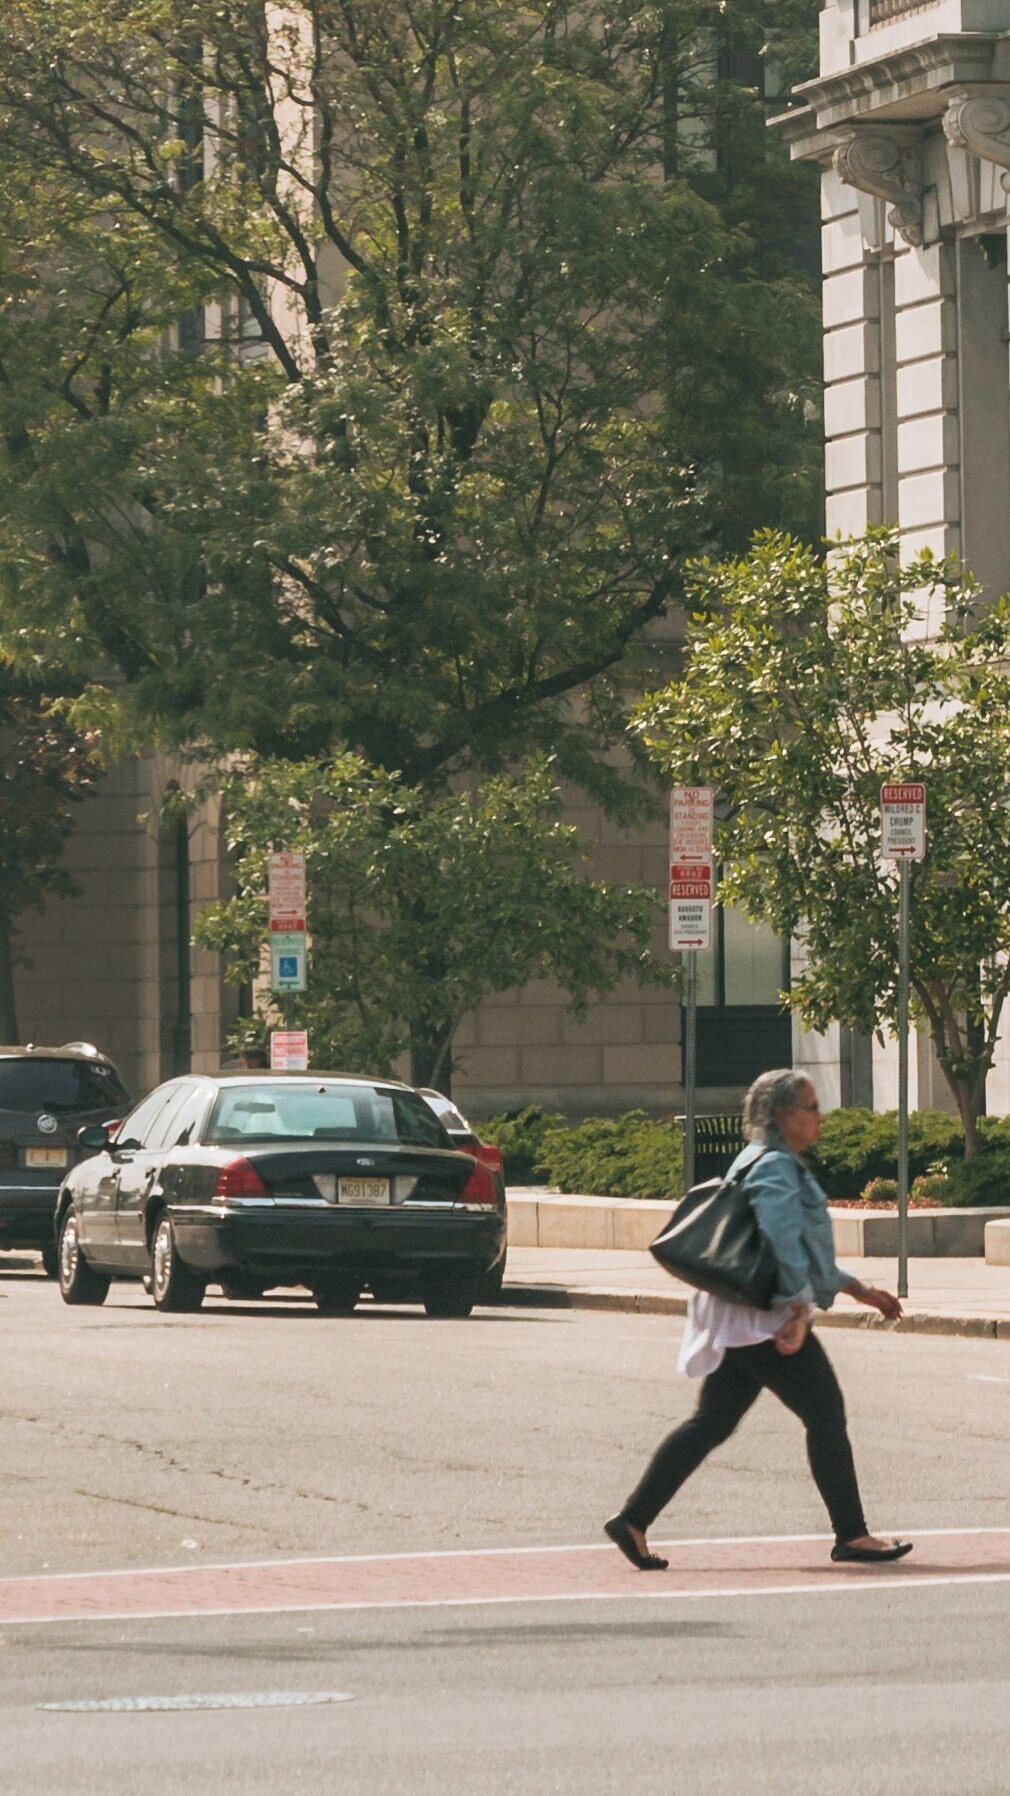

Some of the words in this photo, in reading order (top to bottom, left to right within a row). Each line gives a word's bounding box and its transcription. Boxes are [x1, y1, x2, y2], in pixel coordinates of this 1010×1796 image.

[684, 790, 700, 798] NO
[884, 787, 923, 800] RESERVED
[672, 799, 709, 807] PARKING
[884, 805, 914, 813] MILDRED
[673, 812, 709, 820] STANDING
[890, 817, 914, 826] CRUMP
[672, 884, 709, 896] RESERVED
